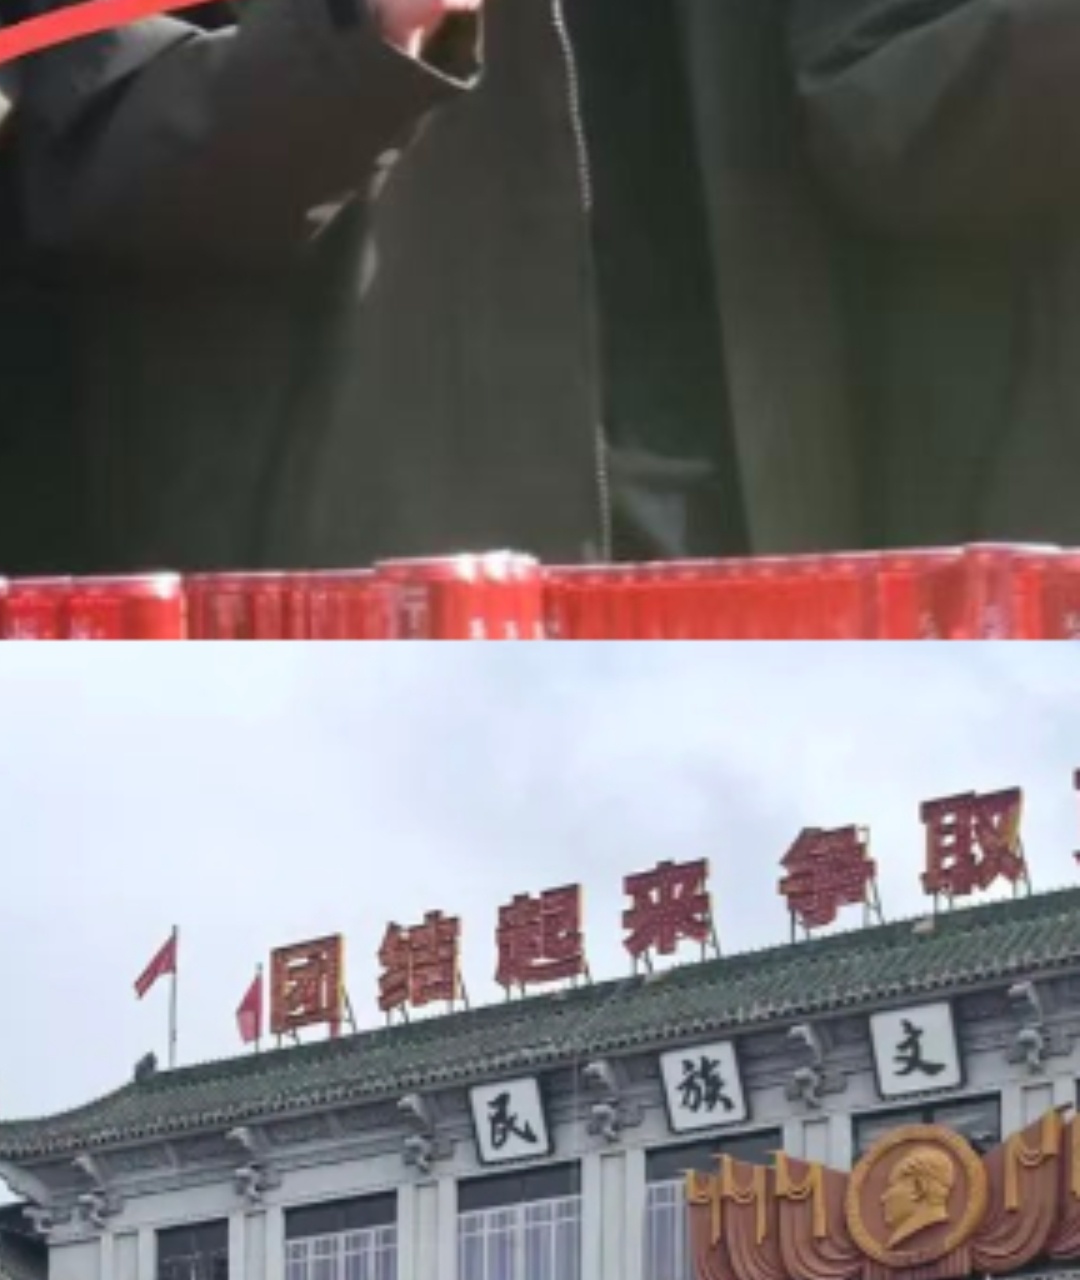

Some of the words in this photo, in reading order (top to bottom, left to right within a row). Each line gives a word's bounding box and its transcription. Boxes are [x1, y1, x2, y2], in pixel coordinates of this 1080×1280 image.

[270, 786, 1080, 1033] 团结起来争取
